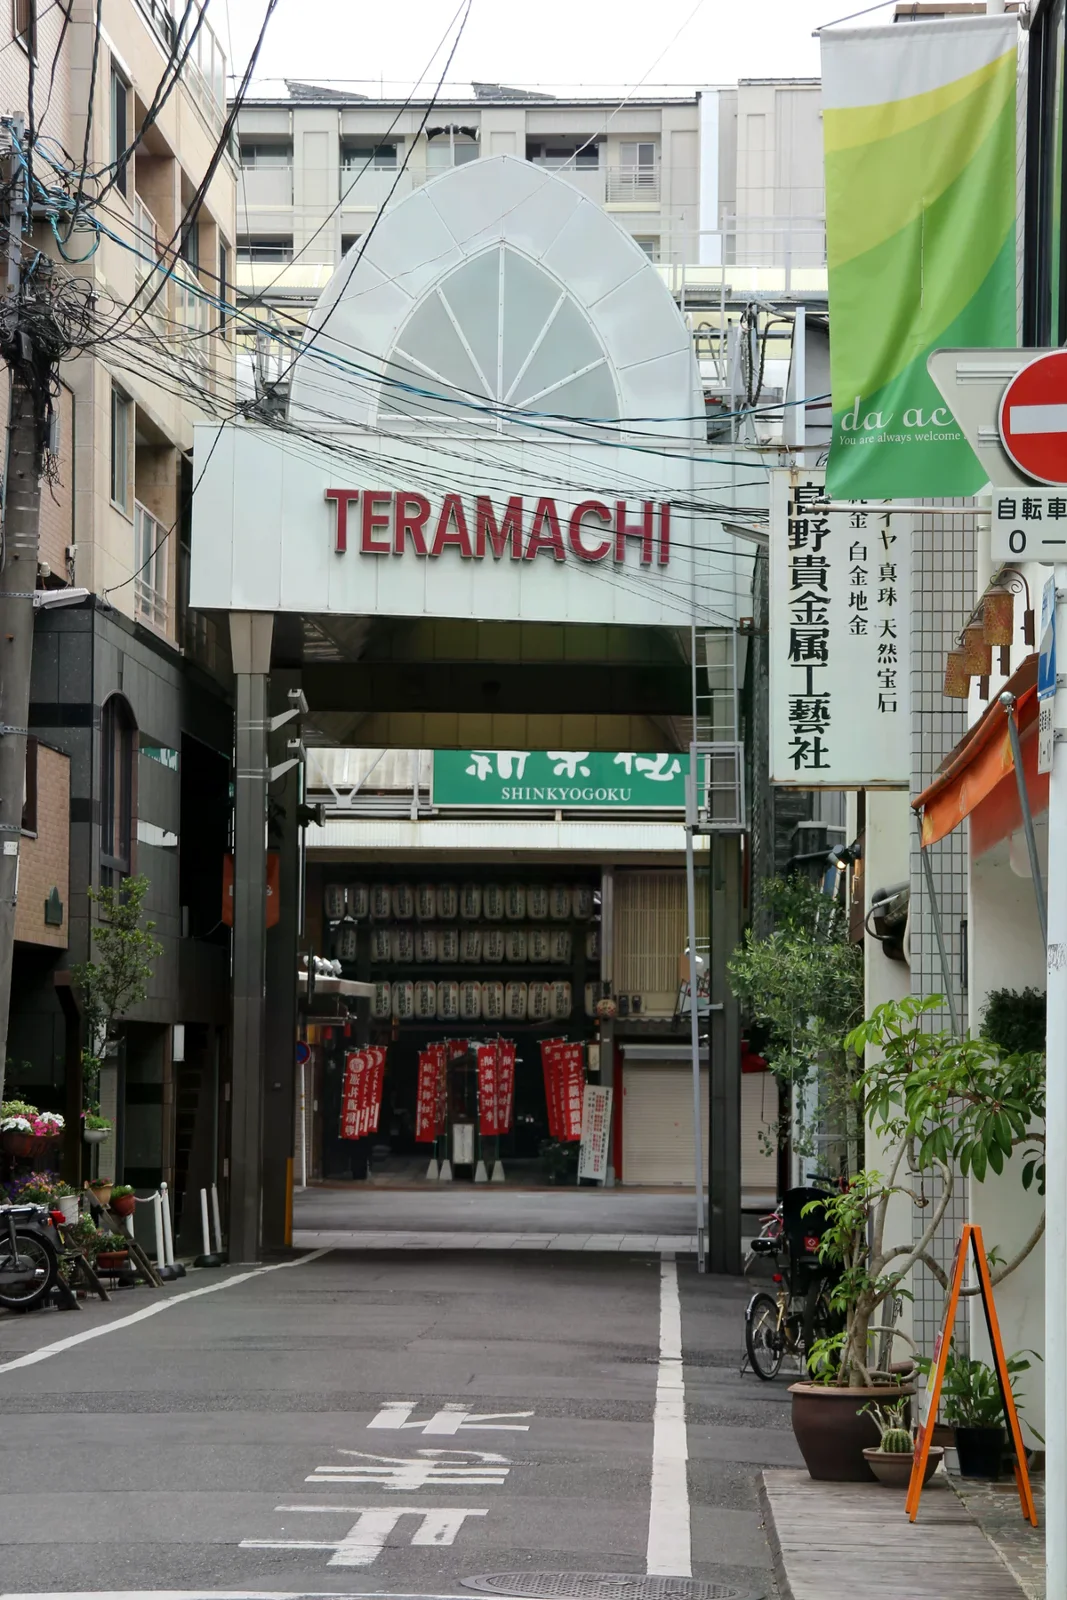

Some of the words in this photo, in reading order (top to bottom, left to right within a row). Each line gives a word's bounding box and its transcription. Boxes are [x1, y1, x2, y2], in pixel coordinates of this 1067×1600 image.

[841, 395, 893, 431] da
[840, 436, 856, 445] You
[859, 436, 874, 445] are
[877, 432, 911, 444] always
[914, 431, 960, 441] welcome
[325, 489, 670, 565] TERAMACHI
[502, 787, 632, 801] SHINKYOGOKU
